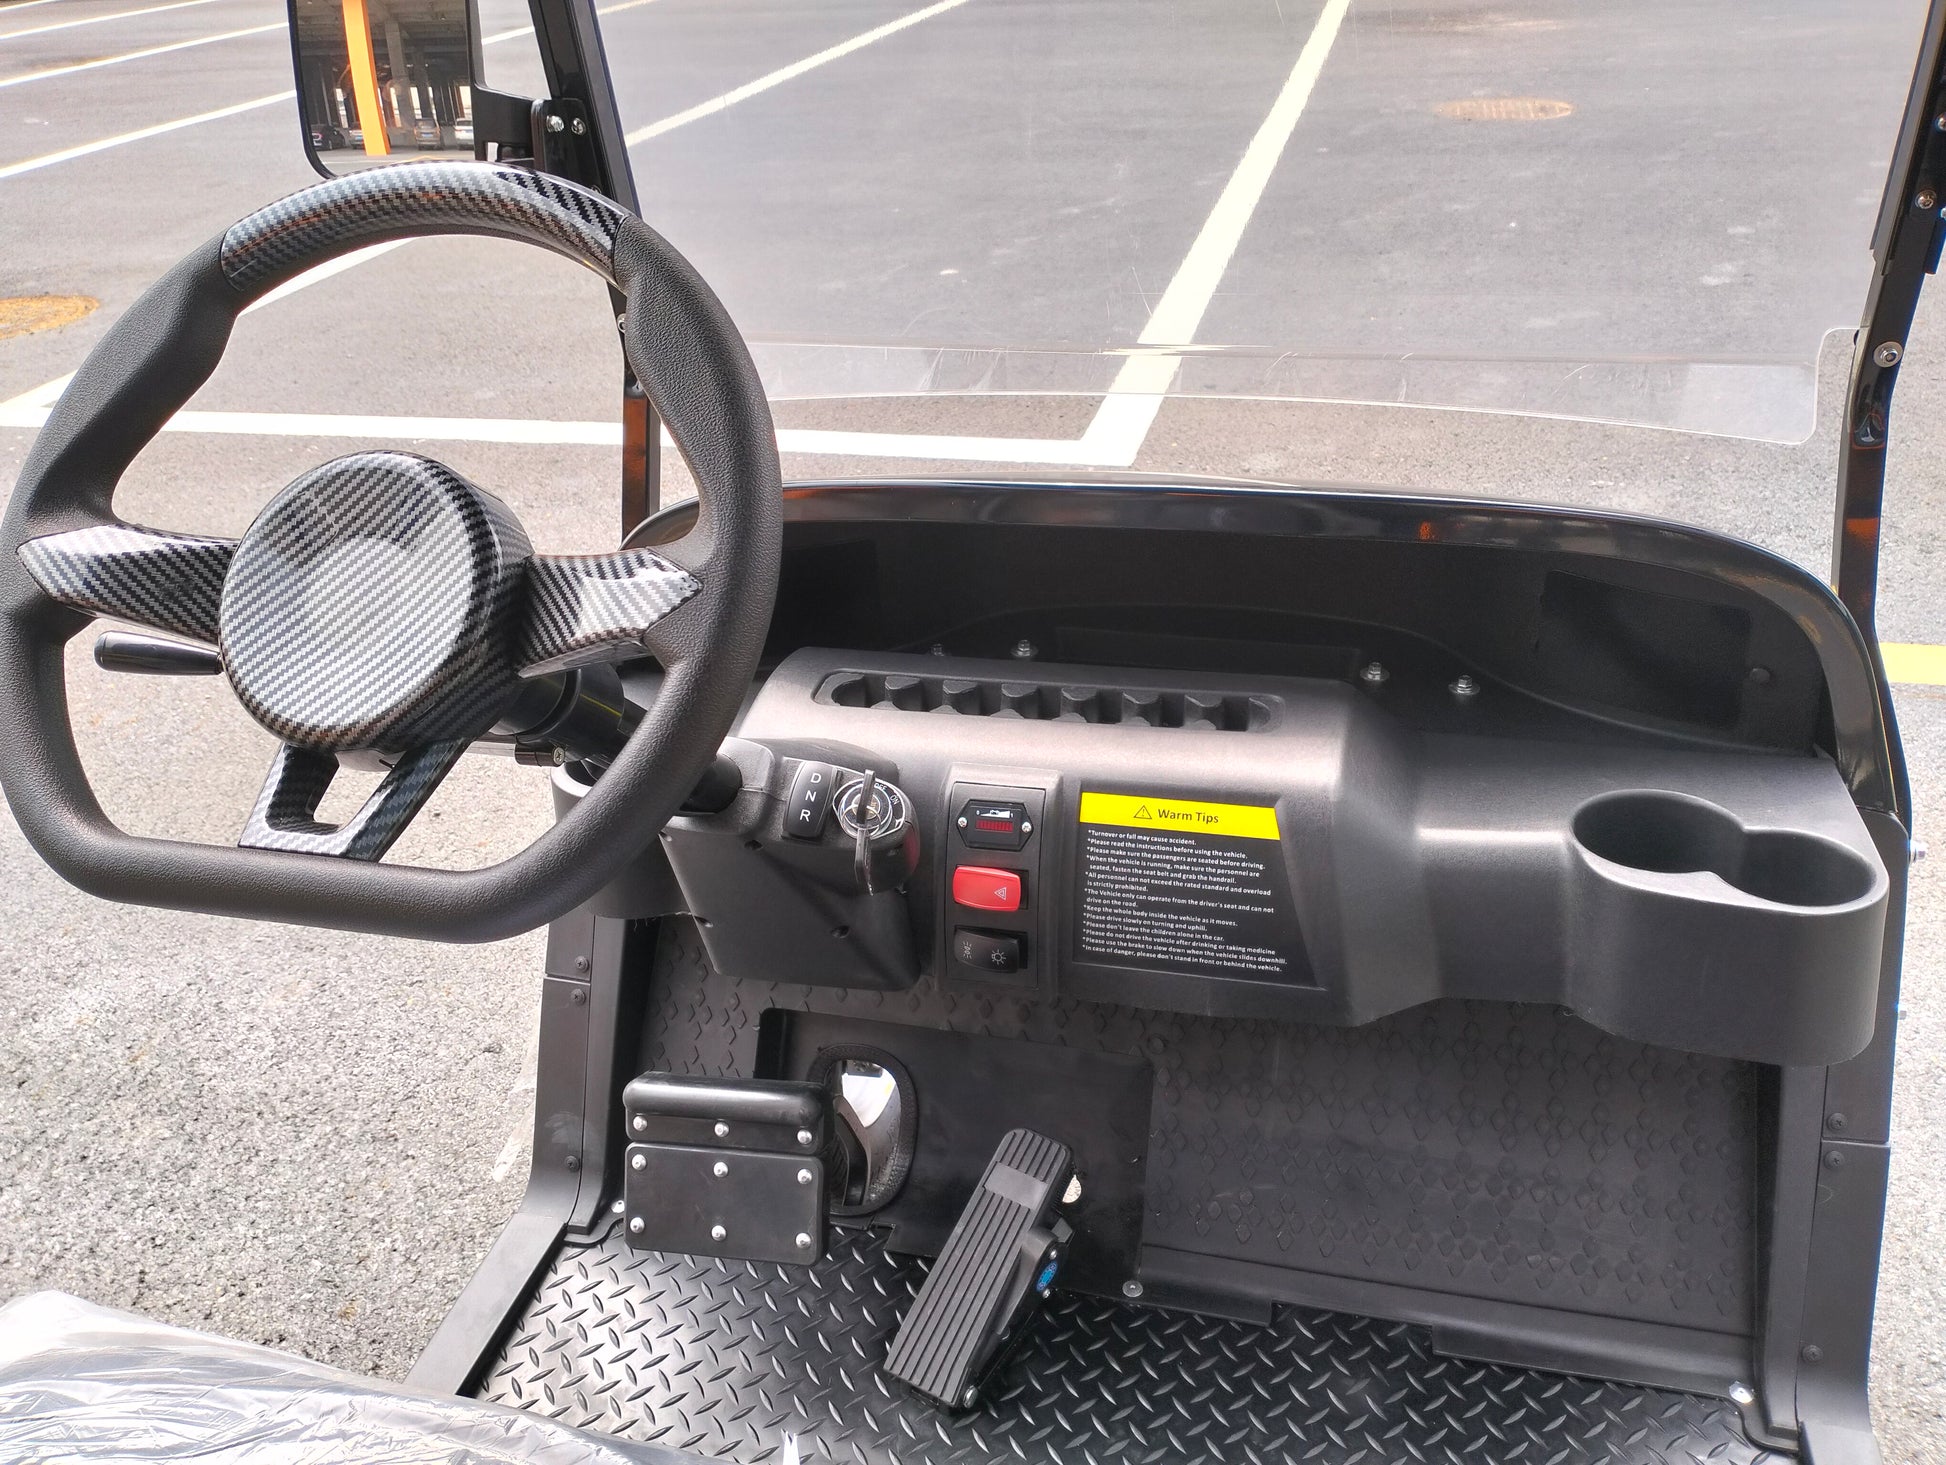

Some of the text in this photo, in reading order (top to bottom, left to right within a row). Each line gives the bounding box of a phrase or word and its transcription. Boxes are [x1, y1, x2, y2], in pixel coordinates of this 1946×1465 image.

[810, 772, 822, 784] D
[805, 789, 817, 802] N
[799, 808, 811, 822] R
[1158, 808, 1219, 825] Warm Tips
[1136, 842, 1172, 851] instructions
[1173, 845, 1193, 853] before
[1194, 848, 1211, 856] using
[1152, 853, 1185, 861] passengers
[1240, 861, 1265, 870] driving.
[1114, 883, 1148, 891] prohibited.
[1099, 889, 1121, 897] Vehicle
[1198, 899, 1222, 907] driver's
[1132, 909, 1147, 917] body
[1122, 916, 1142, 924] slowly
[1151, 920, 1174, 928] turning
[1113, 948, 1135, 956] danger,
[1191, 940, 1217, 949] drinking
[1225, 944, 1245, 952] taking
